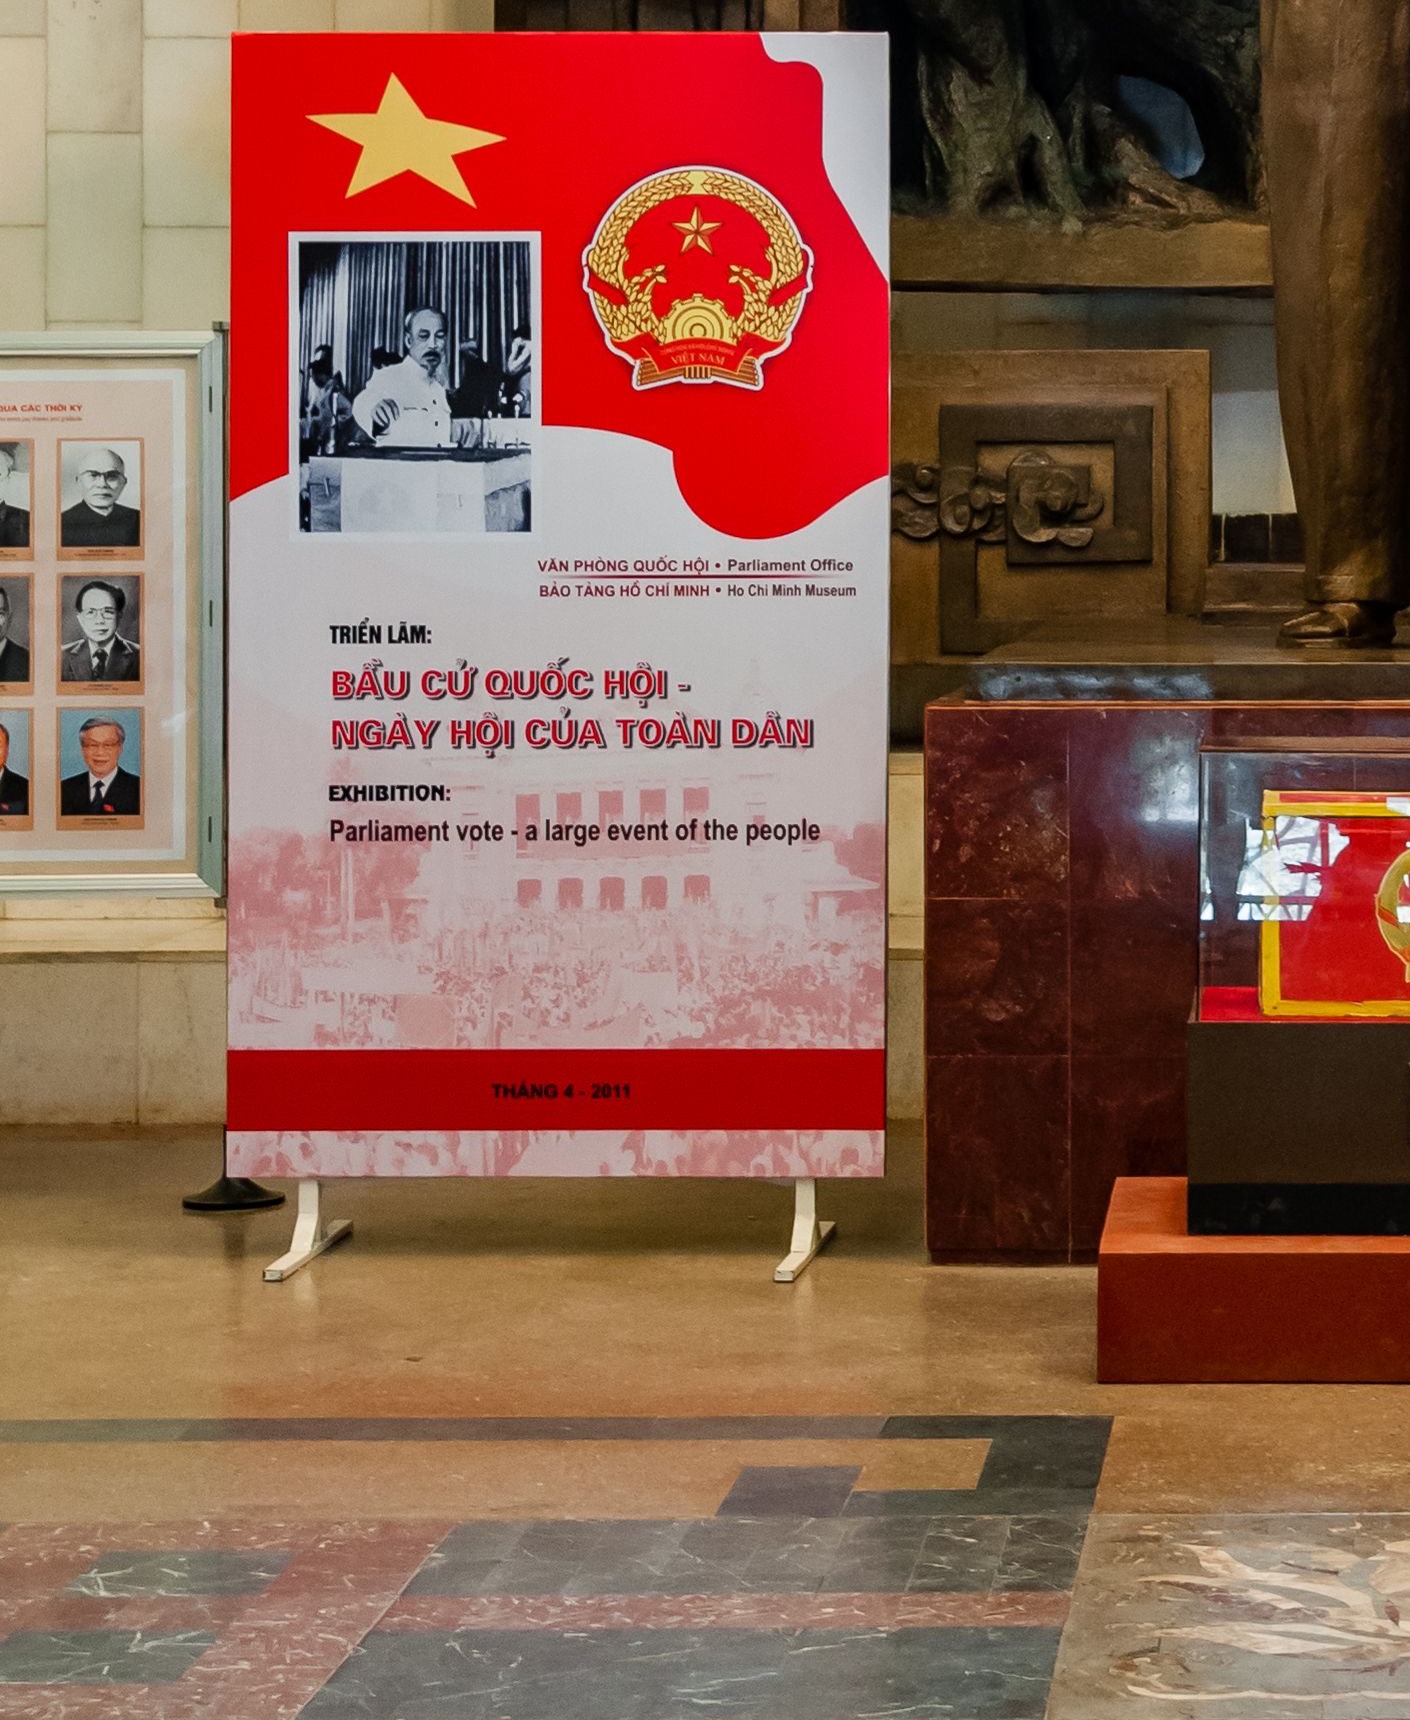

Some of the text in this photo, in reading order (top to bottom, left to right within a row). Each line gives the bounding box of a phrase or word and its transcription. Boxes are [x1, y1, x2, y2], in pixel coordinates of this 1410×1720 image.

[536, 554, 854, 575] VĂN PHÒNG QUỐC HỘI Parliament Office
[644, 581, 670, 598] CHÍ
[673, 584, 710, 597] MINH
[727, 583, 745, 597] Ho
[747, 583, 769, 597] Chi
[771, 583, 802, 597] Minh
[805, 583, 857, 597] Museum
[328, 616, 432, 645] TRIỂN LÃM:
[331, 658, 412, 702] BẦU
[420, 657, 480, 702] CỬ
[484, 656, 595, 702] QUỐC
[603, 661, 669, 709] HỘI
[331, 706, 815, 759] NGÀY HỘI CỦA TOÀN DÂN
[328, 784, 451, 803] EXHIBITION:
[330, 819, 450, 842] Parliament
[456, 820, 504, 842] vote
[524, 824, 538, 841] a
[545, 818, 601, 847] large
[607, 819, 669, 841] event
[675, 818, 698, 841] of
[703, 818, 739, 841] the
[746, 817, 821, 846] people
[491, 1080, 559, 1099] THÁNG
[563, 1083, 574, 1099] 4
[591, 1083, 630, 1099] 2011
